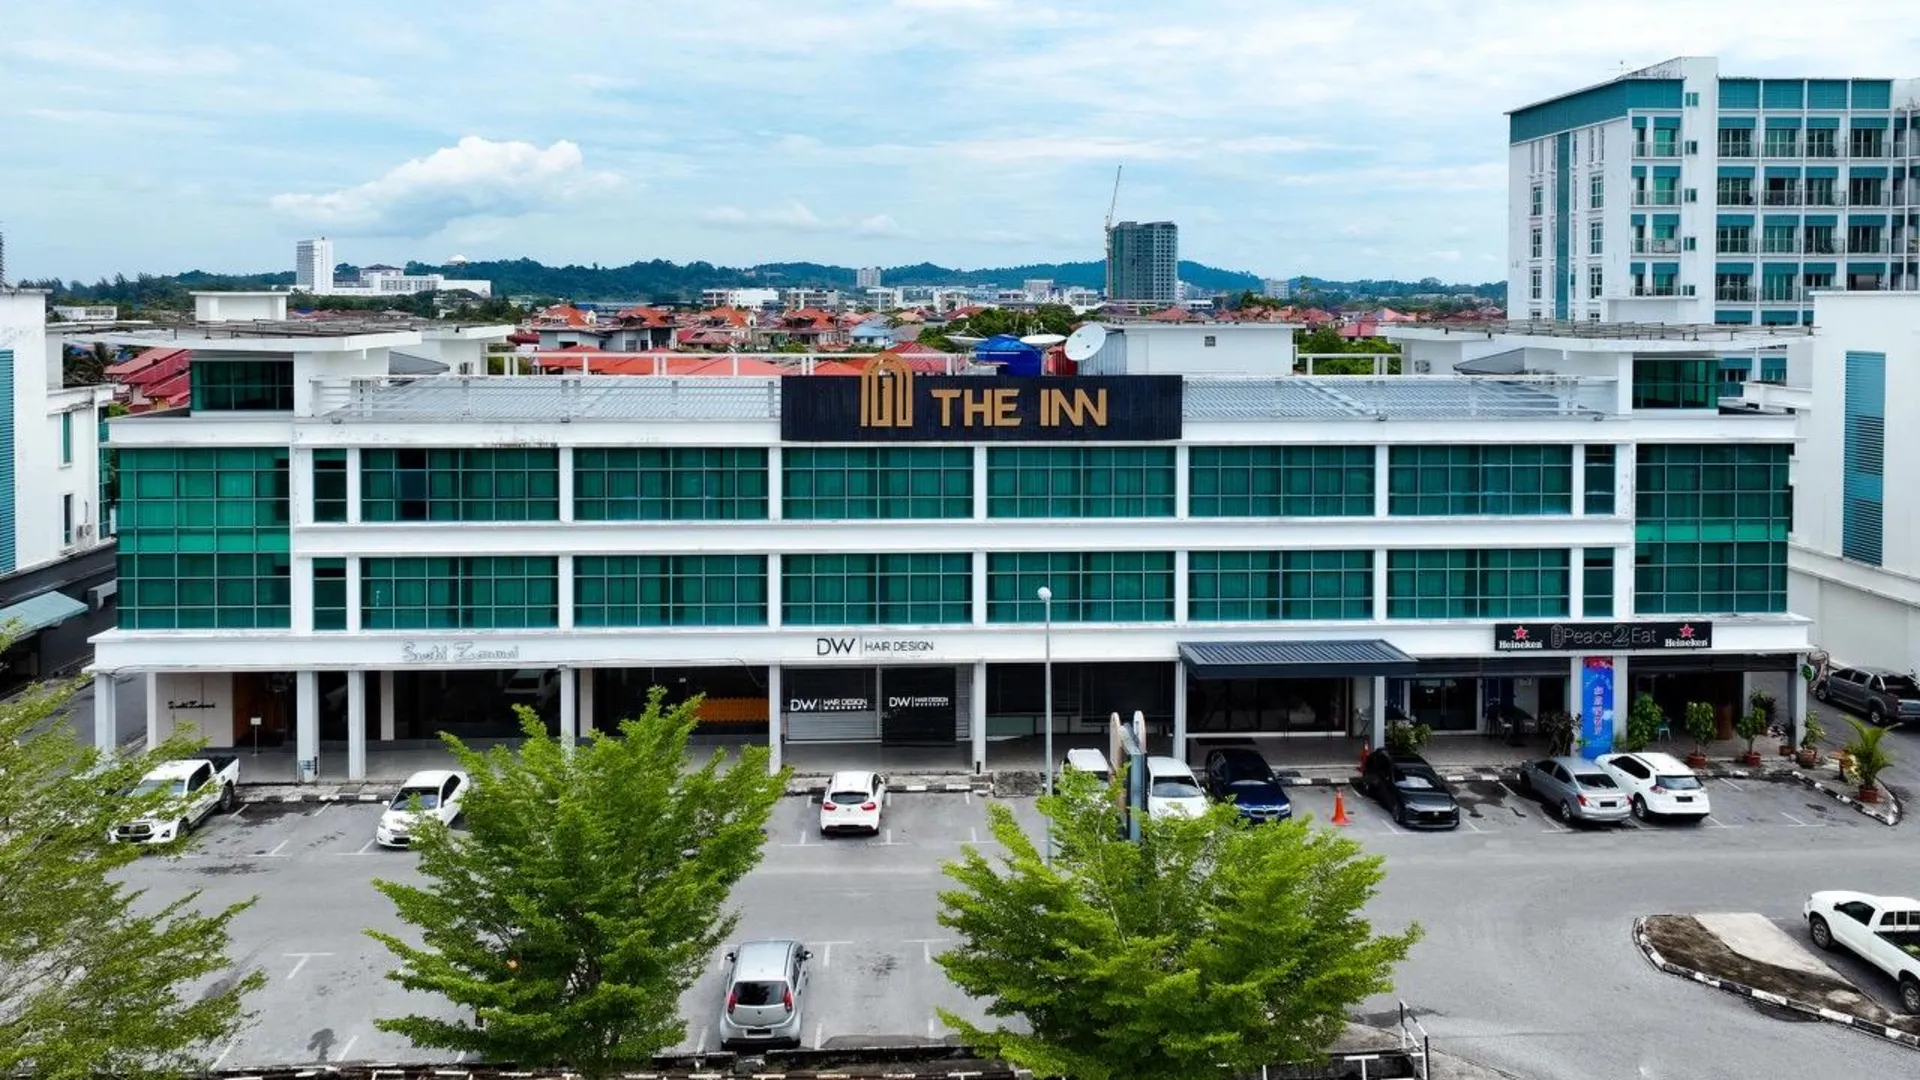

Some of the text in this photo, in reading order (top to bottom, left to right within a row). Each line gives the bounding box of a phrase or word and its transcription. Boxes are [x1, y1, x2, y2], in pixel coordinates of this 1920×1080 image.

[931, 388, 1107, 427] THE INN
[816, 637, 934, 655] DW HAIR DESIGN
[1499, 639, 1543, 649] Heineken
[1665, 637, 1709, 648] Heineken
[790, 698, 818, 711] DW
[889, 696, 911, 707] DW
